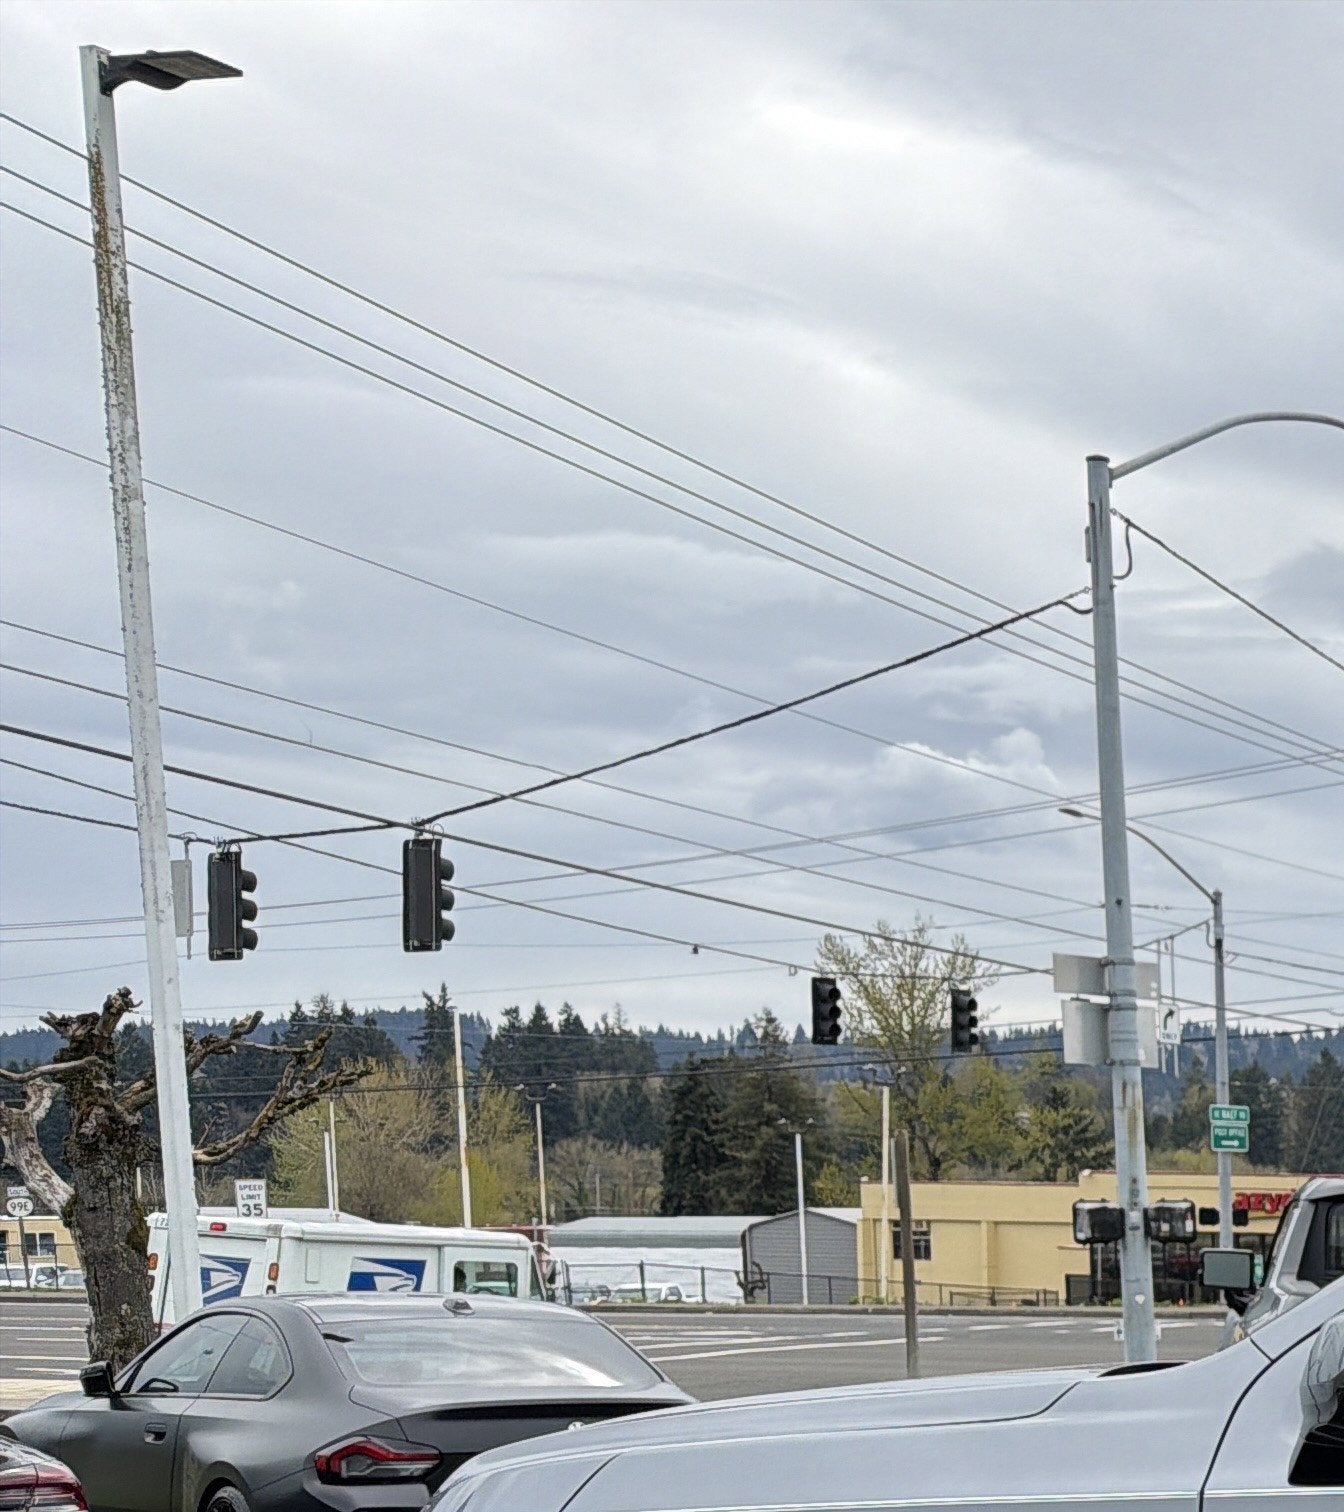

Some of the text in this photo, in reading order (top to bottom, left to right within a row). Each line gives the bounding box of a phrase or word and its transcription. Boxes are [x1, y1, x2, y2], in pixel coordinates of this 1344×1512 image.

[238, 1184, 263, 1192] SPEED
[241, 1193, 261, 1201] LIMIT
[10, 1200, 30, 1212] 99E
[241, 1203, 264, 1218] 35
